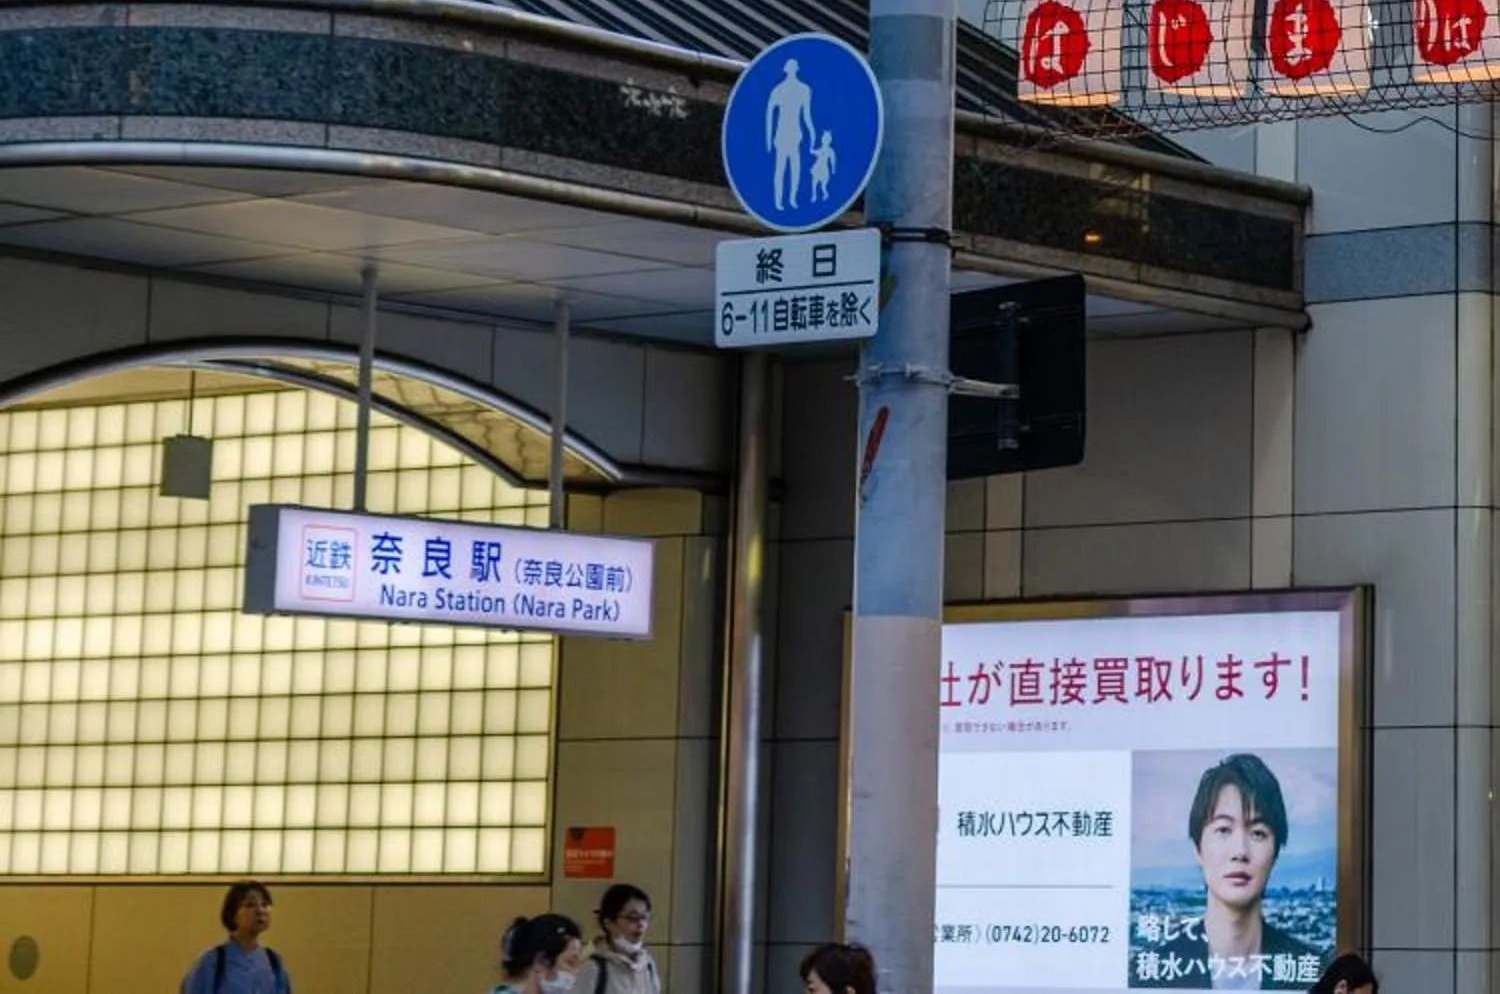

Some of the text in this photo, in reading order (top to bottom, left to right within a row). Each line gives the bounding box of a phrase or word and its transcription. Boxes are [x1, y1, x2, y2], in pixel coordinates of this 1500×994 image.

[756, 244, 836, 284] 終日
[721, 293, 871, 337] 6-11自転車を除く
[305, 539, 352, 570] 近鉄
[371, 532, 501, 582] 奈良駅
[380, 584, 427, 608] Nara
[435, 587, 505, 614] Station
[514, 594, 565, 618] (Nara
[572, 598, 620, 622] Park)
[957, 811, 1113, 838] 積水ハウス不動産
[1136, 952, 1321, 983] 積水ハウス不動産
